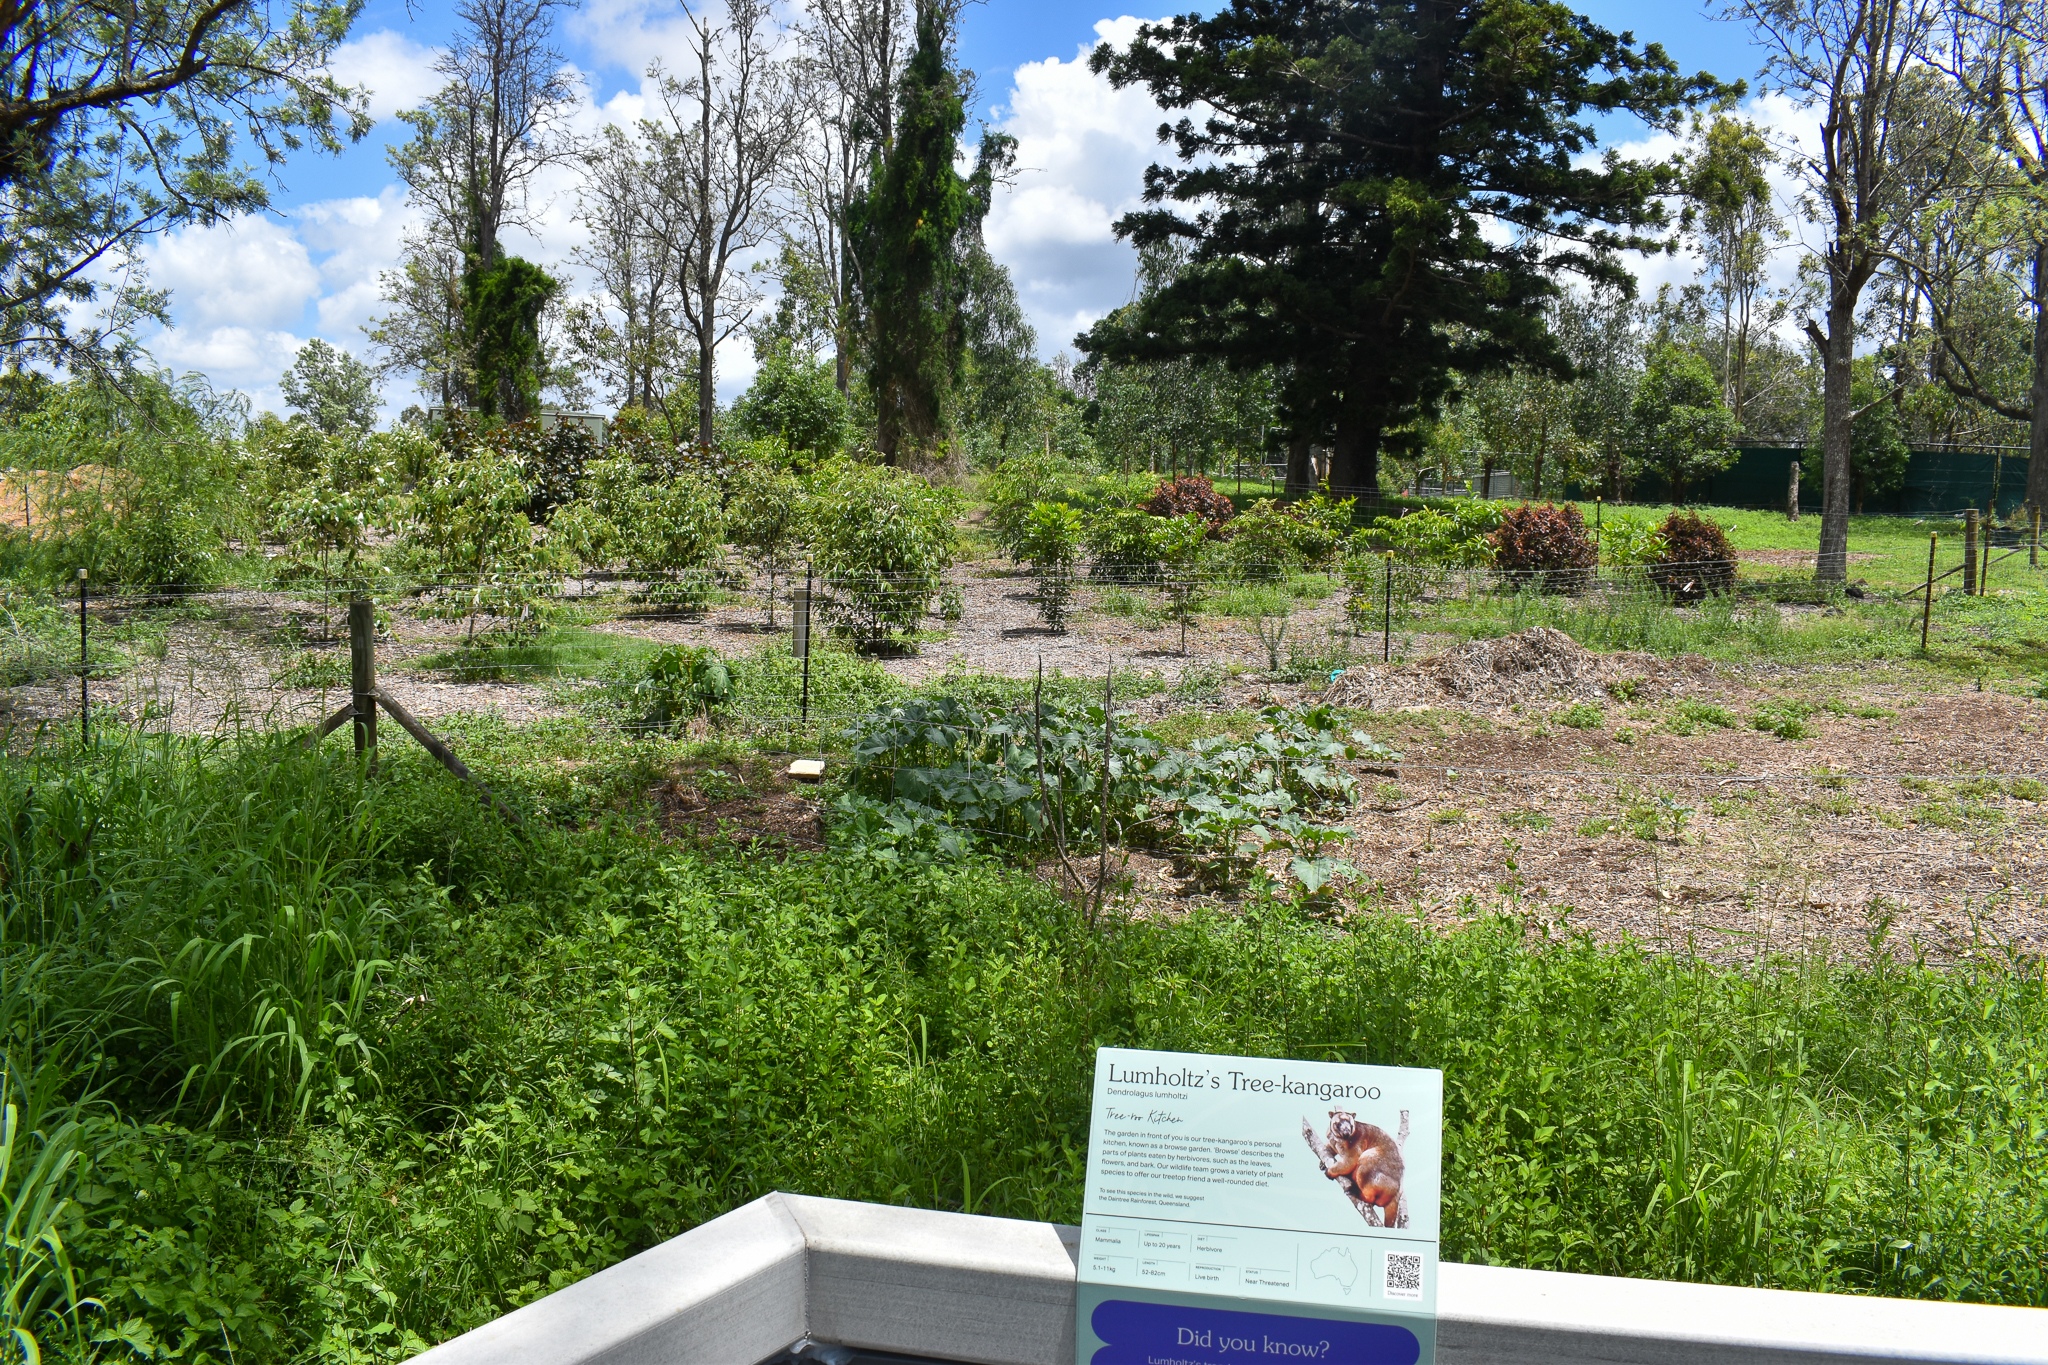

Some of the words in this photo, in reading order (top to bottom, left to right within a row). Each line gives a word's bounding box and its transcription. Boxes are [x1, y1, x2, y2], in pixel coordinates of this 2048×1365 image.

[1109, 1063, 1219, 1089] Lumholtz's
[1228, 1071, 1380, 1101] Tree-kangaroo
[1107, 1087, 1153, 1098] Dendrolagus
[1154, 1091, 1187, 1099] lumholtzi
[1147, 1109, 1183, 1124] Kitchen
[1202, 1137, 1252, 1146] tree-kangaroo's
[1103, 1139, 1127, 1147] kitchen,
[1240, 1149, 1272, 1157] describes
[1101, 1158, 1125, 1166] flowers,
[1162, 1173, 1185, 1181] treetop
[1212, 1178, 1254, 1186] well-rounded
[1093, 1264, 1115, 1273] 5.1-11kg
[1259, 1279, 1289, 1287] Threatened
[1177, 1327, 1211, 1347] Did
[1219, 1337, 1255, 1352] you
[1263, 1335, 1329, 1358] know?
